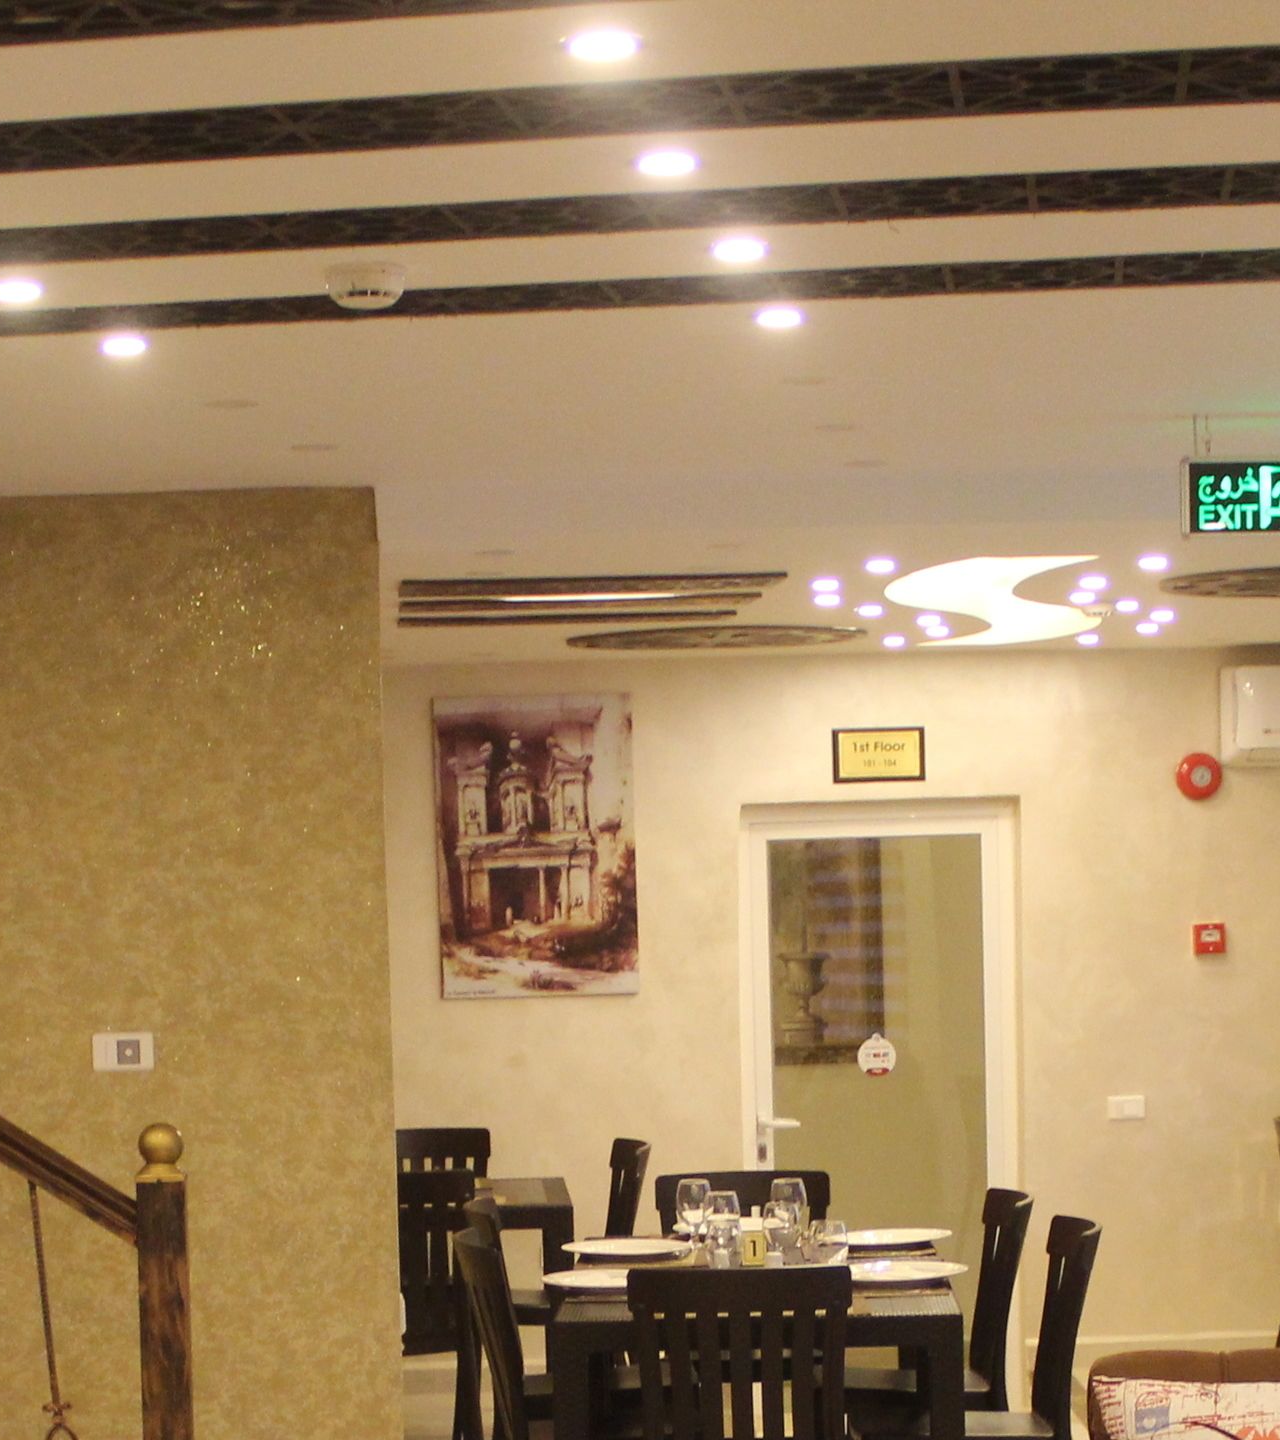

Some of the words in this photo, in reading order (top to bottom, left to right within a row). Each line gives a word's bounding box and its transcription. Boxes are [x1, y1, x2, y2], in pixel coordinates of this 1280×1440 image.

[1198, 467, 1259, 503] خروج
[1198, 504, 1259, 530] EXIT
[853, 742, 869, 753] 1st
[874, 741, 905, 752] Floor
[750, 1240, 756, 1257] 1
